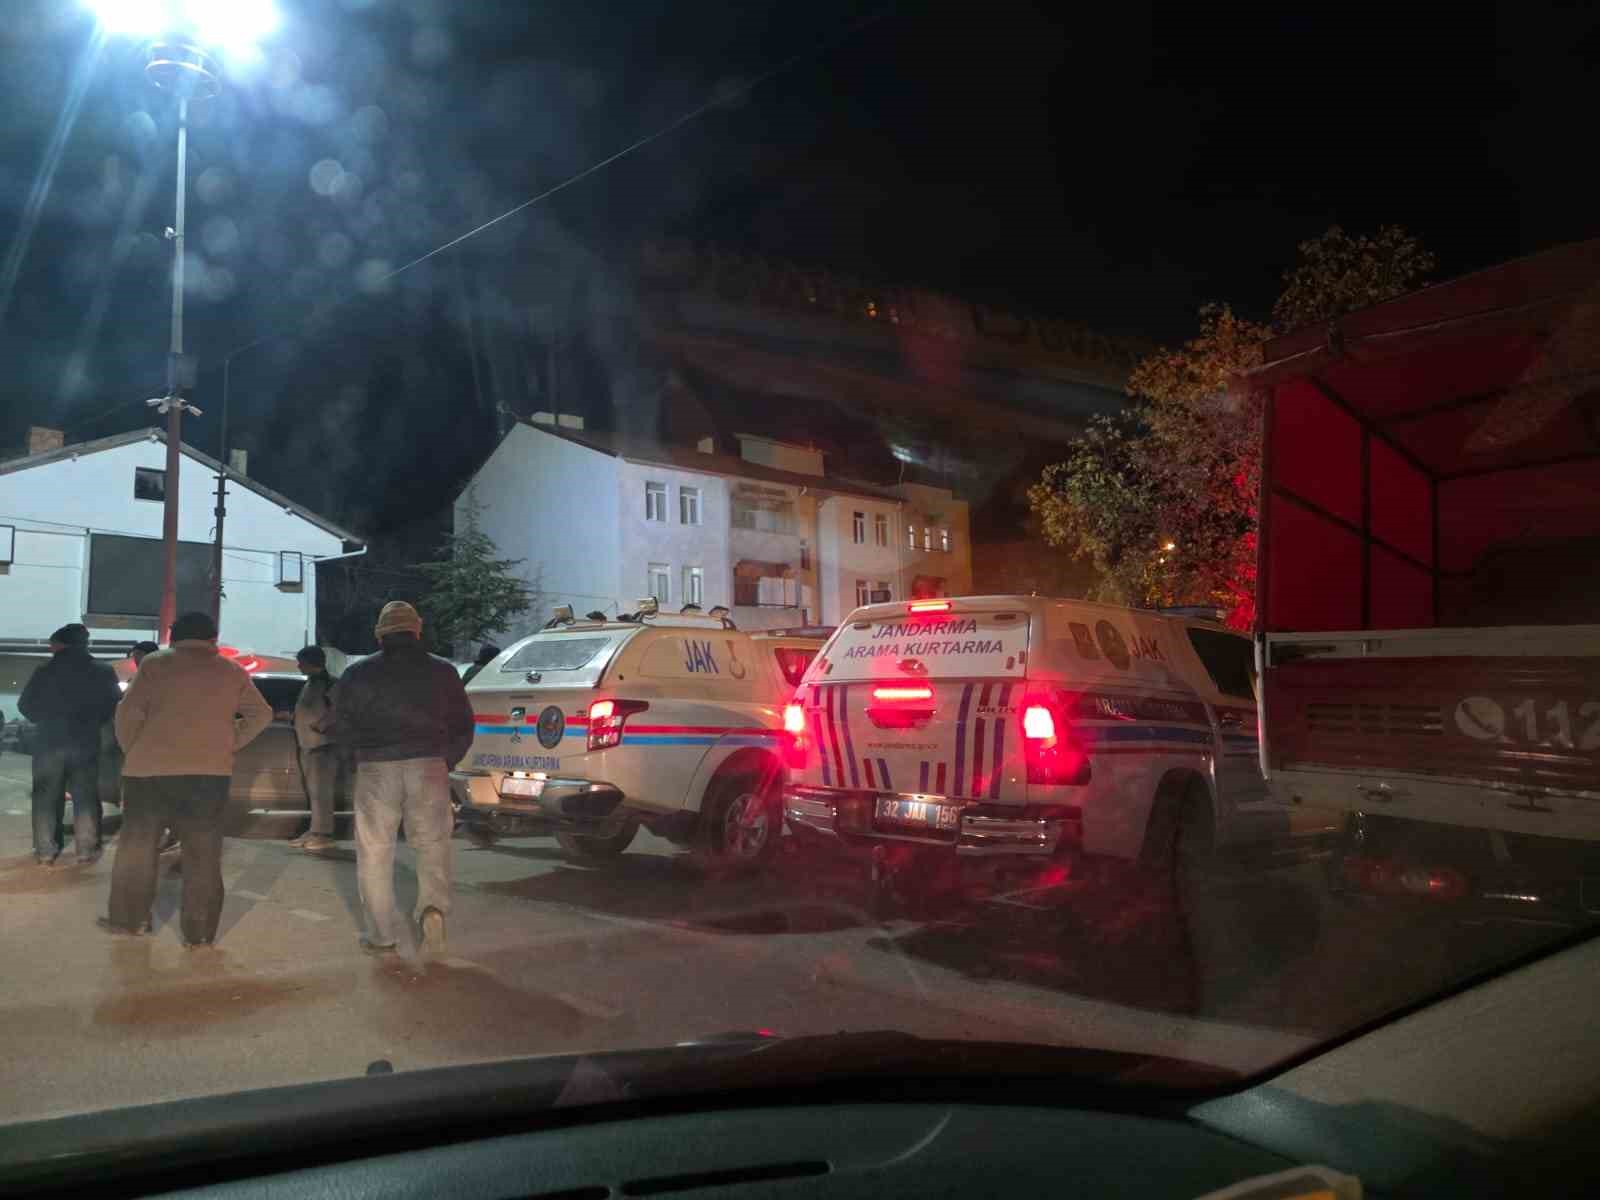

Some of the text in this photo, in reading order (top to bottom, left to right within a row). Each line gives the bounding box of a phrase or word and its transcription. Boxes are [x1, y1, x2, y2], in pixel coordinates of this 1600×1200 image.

[872, 618, 977, 639] JANDARMA
[683, 638, 719, 674] JAK
[844, 639, 1004, 659] ARAMA KURTARMA
[1131, 633, 1166, 662] JAK
[882, 800, 899, 817] 32
[904, 801, 927, 820] JAA
